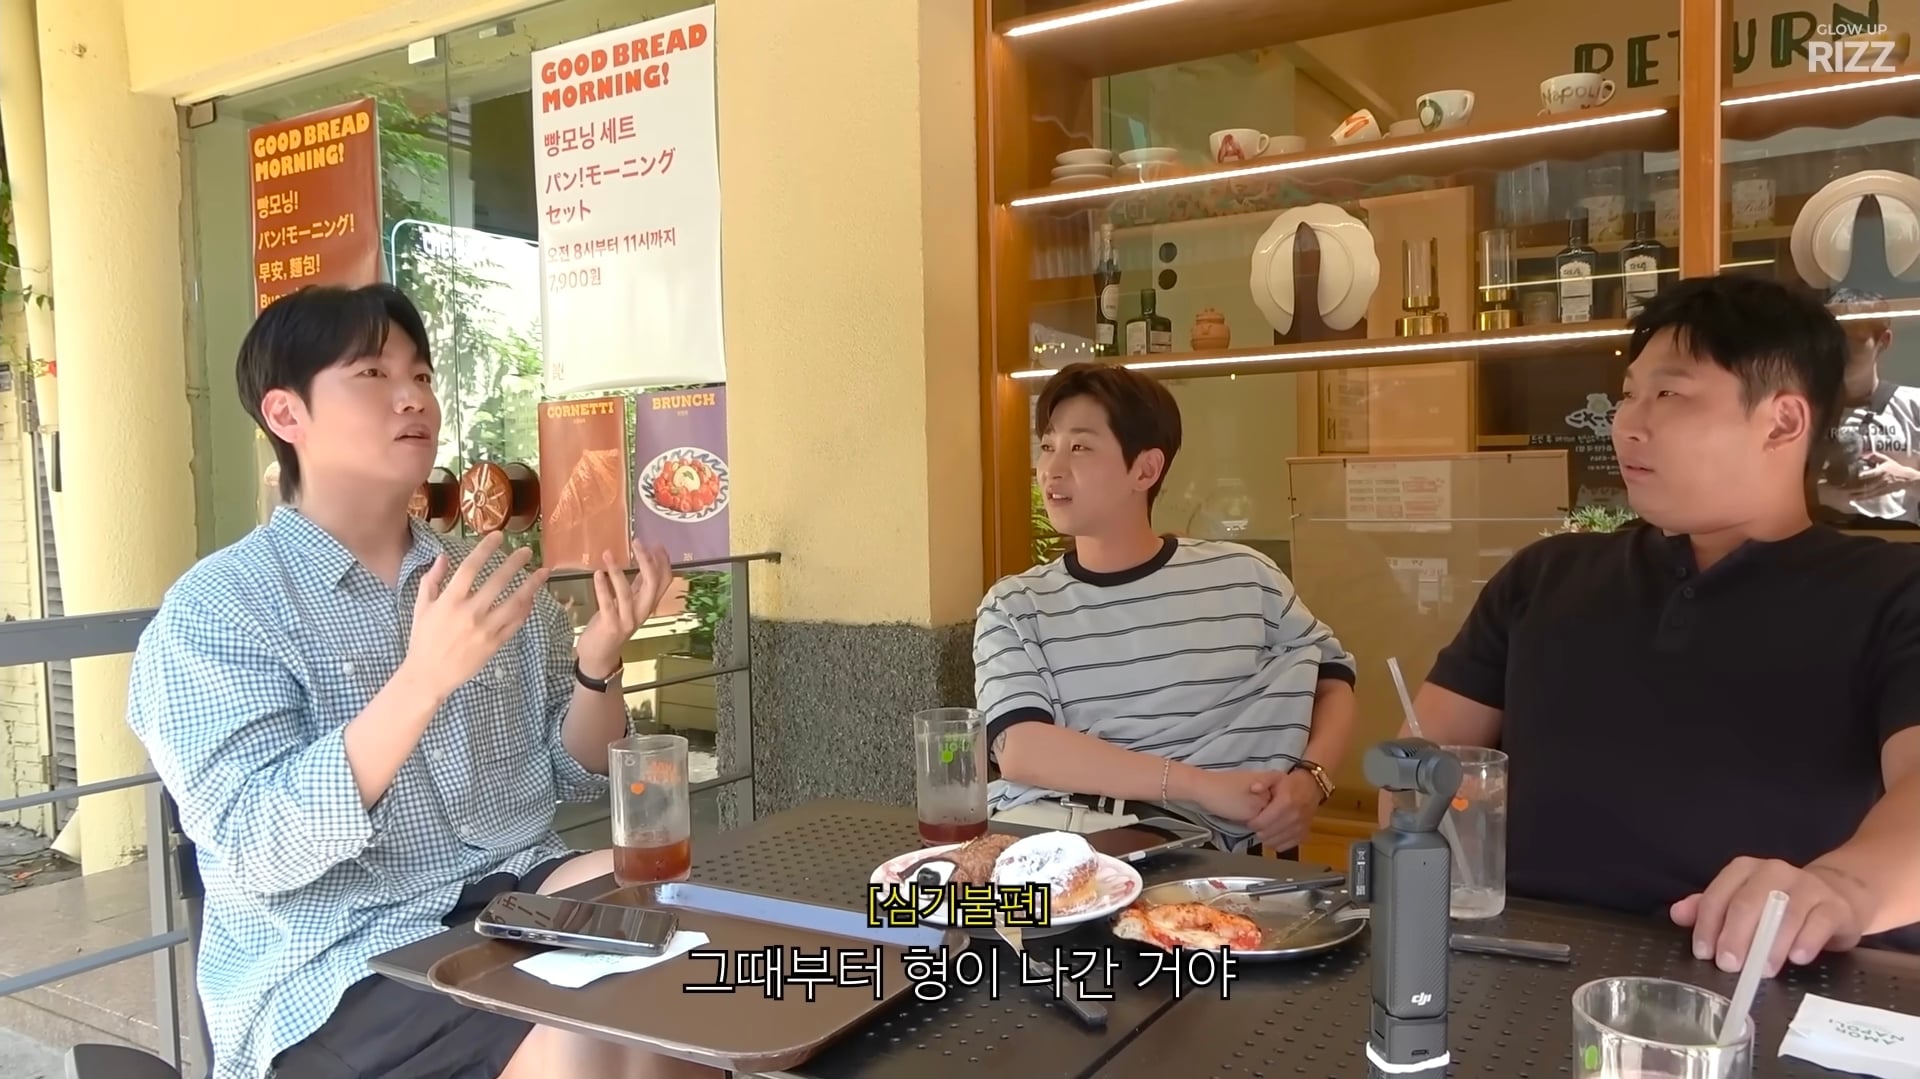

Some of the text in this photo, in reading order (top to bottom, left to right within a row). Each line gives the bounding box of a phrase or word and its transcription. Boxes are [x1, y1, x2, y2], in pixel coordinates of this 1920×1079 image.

[541, 23, 707, 84] GOOD BREAD
[542, 61, 670, 114] MORNING!
[254, 111, 370, 158] GOOD BREAD
[544, 115, 637, 158] 빵모닝 세트
[255, 142, 345, 182] MORNING!
[545, 147, 676, 194] パン!モーニング
[256, 190, 299, 219] 빵모닝!
[546, 199, 592, 225] セット
[258, 213, 355, 250] パン!モーニング!
[547, 227, 677, 263] 오전 8시부터 11시까지
[548, 267, 602, 294] 7,900원
[546, 401, 615, 418] CORNETTI
[652, 393, 716, 411] BRUNCH
